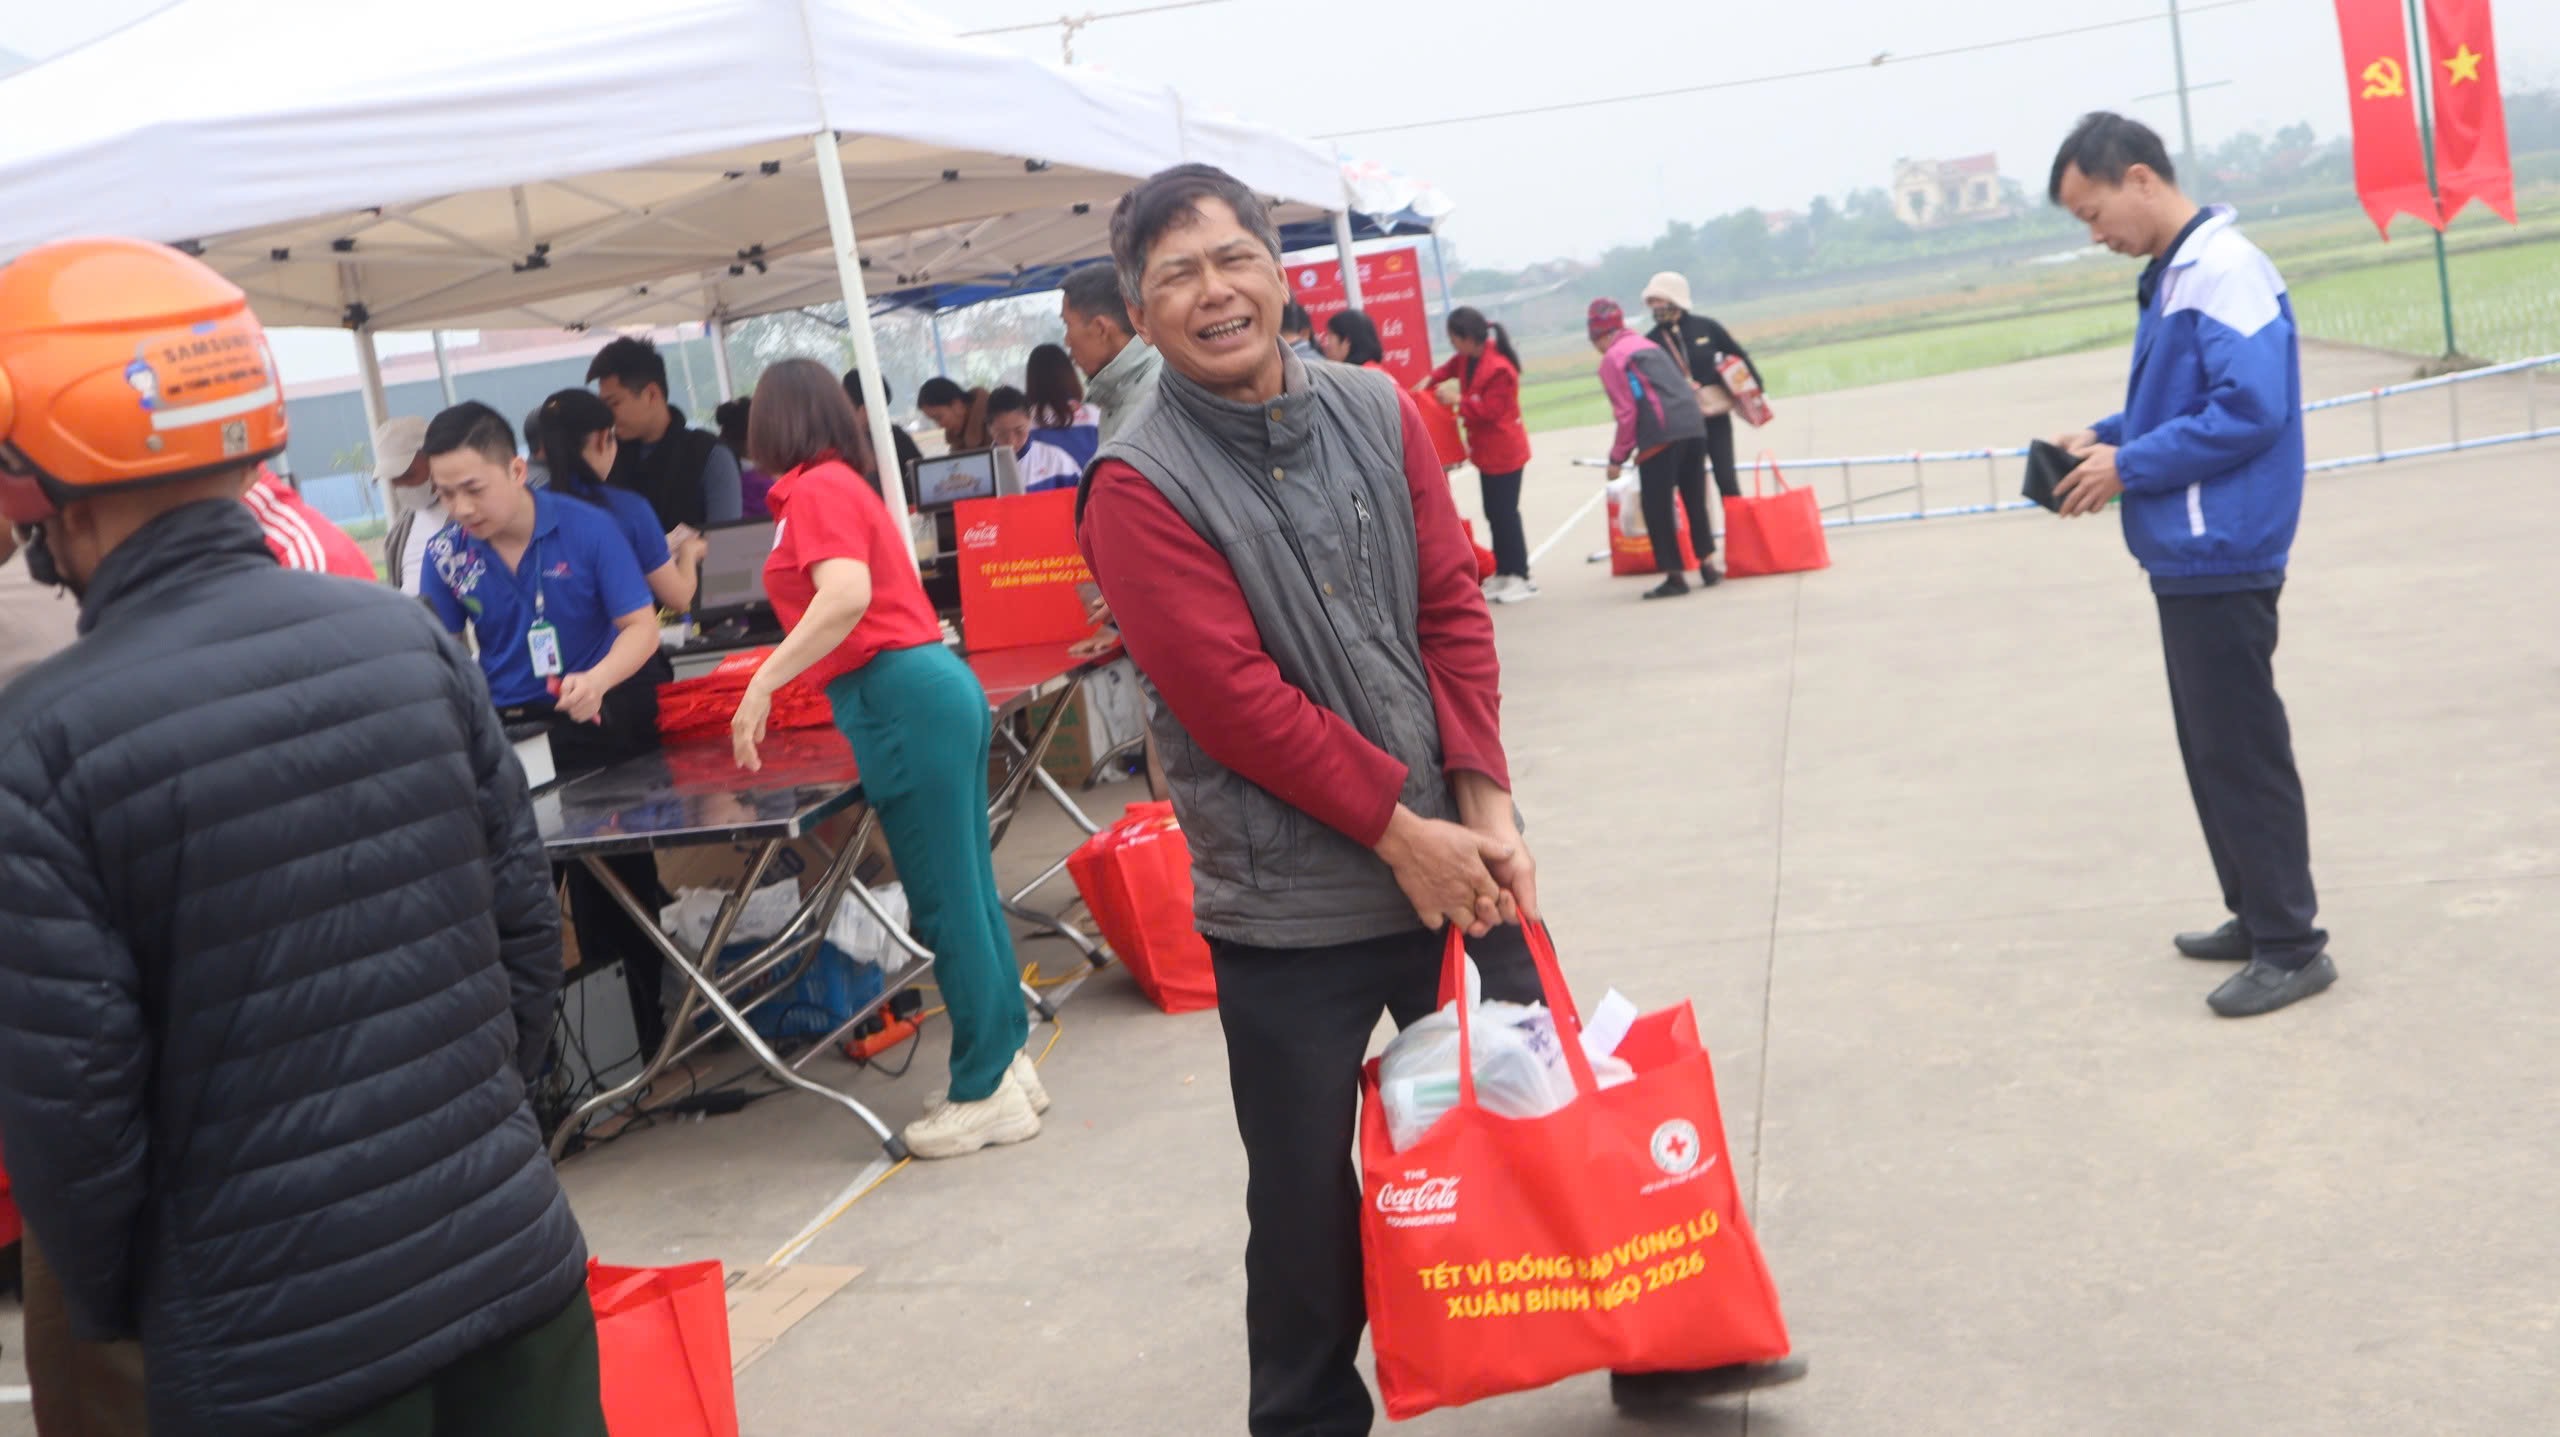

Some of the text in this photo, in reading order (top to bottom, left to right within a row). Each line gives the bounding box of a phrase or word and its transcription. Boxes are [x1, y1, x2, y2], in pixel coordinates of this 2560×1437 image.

[164, 334, 252, 364] SAMSUN
[1403, 1167, 1428, 1182] THE
[1418, 1260, 1462, 1290] TẾT
[1446, 1289, 1521, 1320] XUÂN
[1526, 1283, 1590, 1313] BÍNH
[1643, 1250, 1706, 1292] 2026
